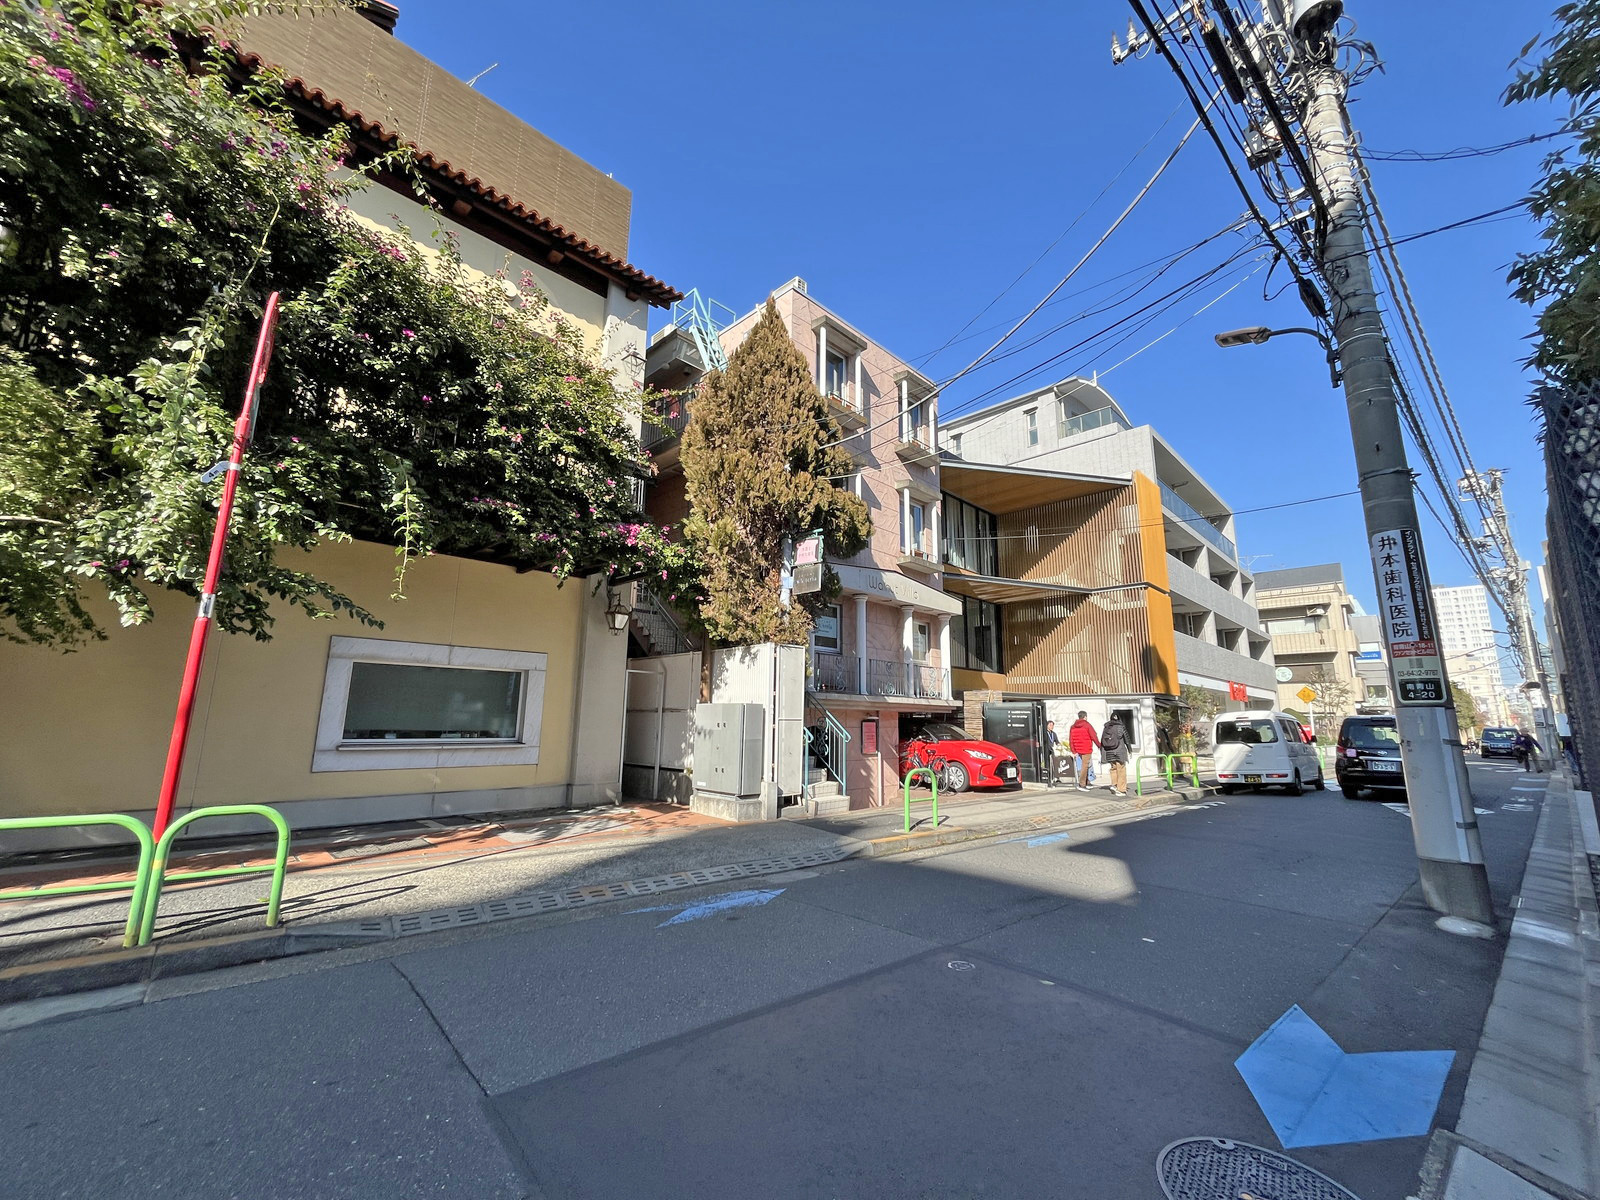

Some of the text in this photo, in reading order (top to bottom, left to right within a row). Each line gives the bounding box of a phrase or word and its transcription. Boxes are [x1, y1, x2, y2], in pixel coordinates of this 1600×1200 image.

[1378, 535, 1413, 638] 井本歯科医院
